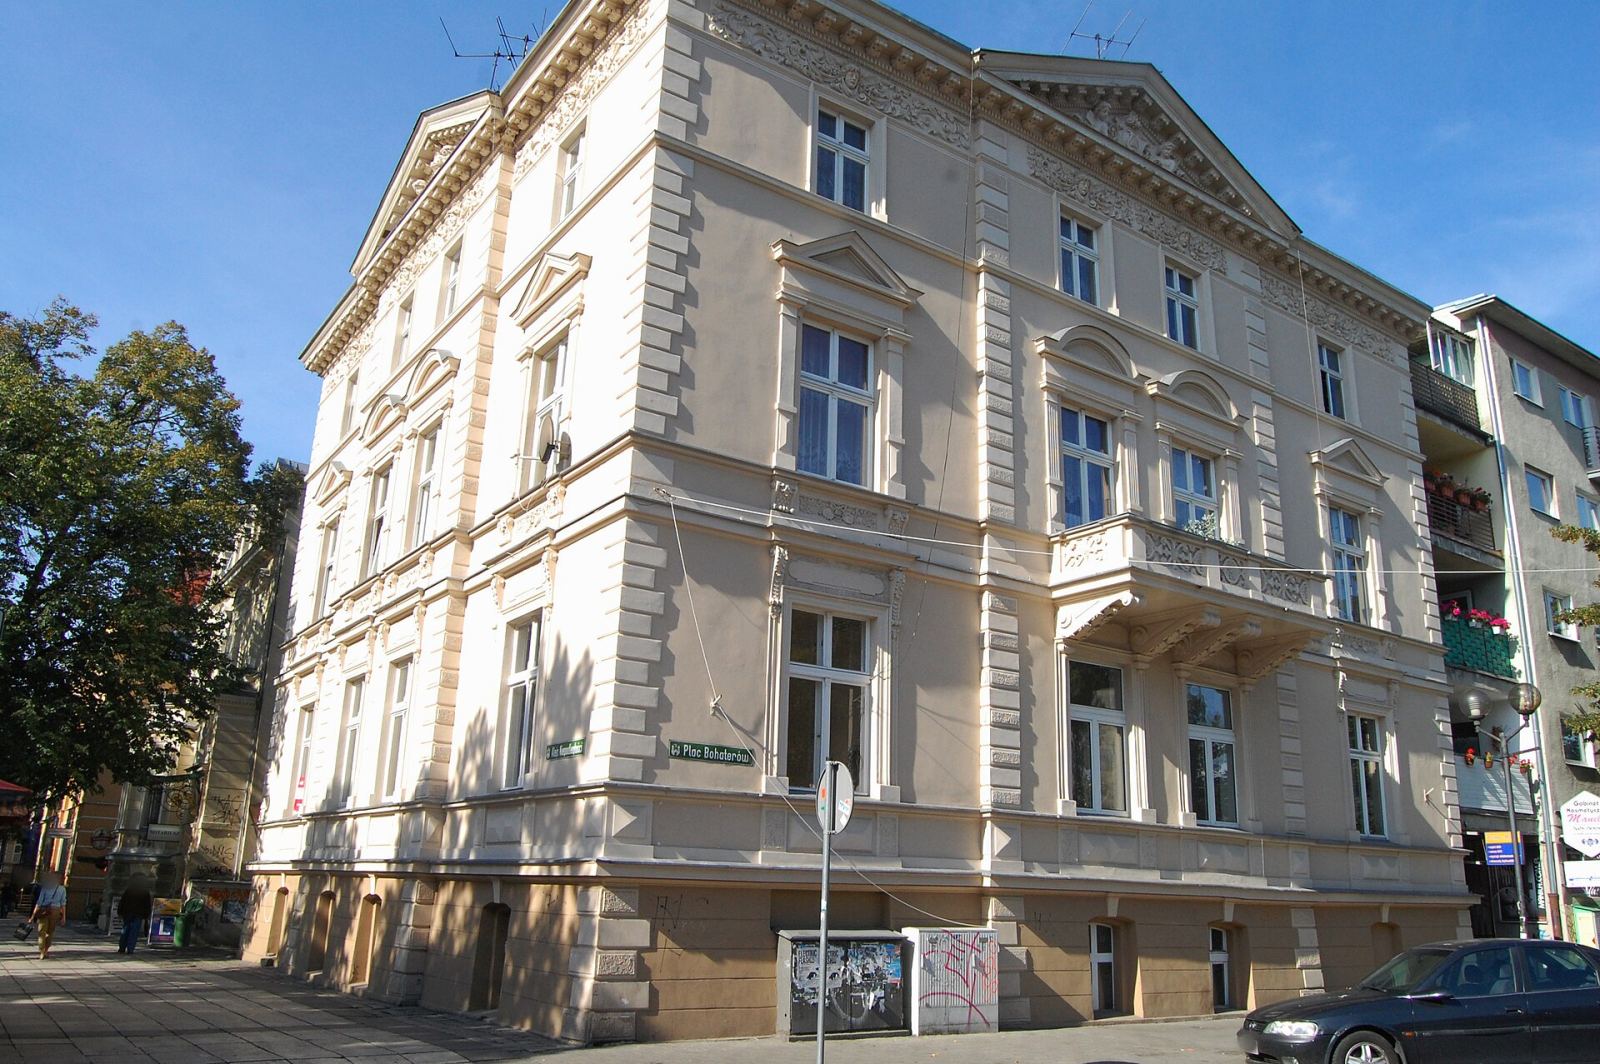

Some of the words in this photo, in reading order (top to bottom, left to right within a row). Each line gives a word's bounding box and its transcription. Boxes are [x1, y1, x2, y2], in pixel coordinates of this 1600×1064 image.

[683, 744, 701, 758] Plac
[703, 747, 749, 763] Bohaterów
[158, 919, 171, 936] L
